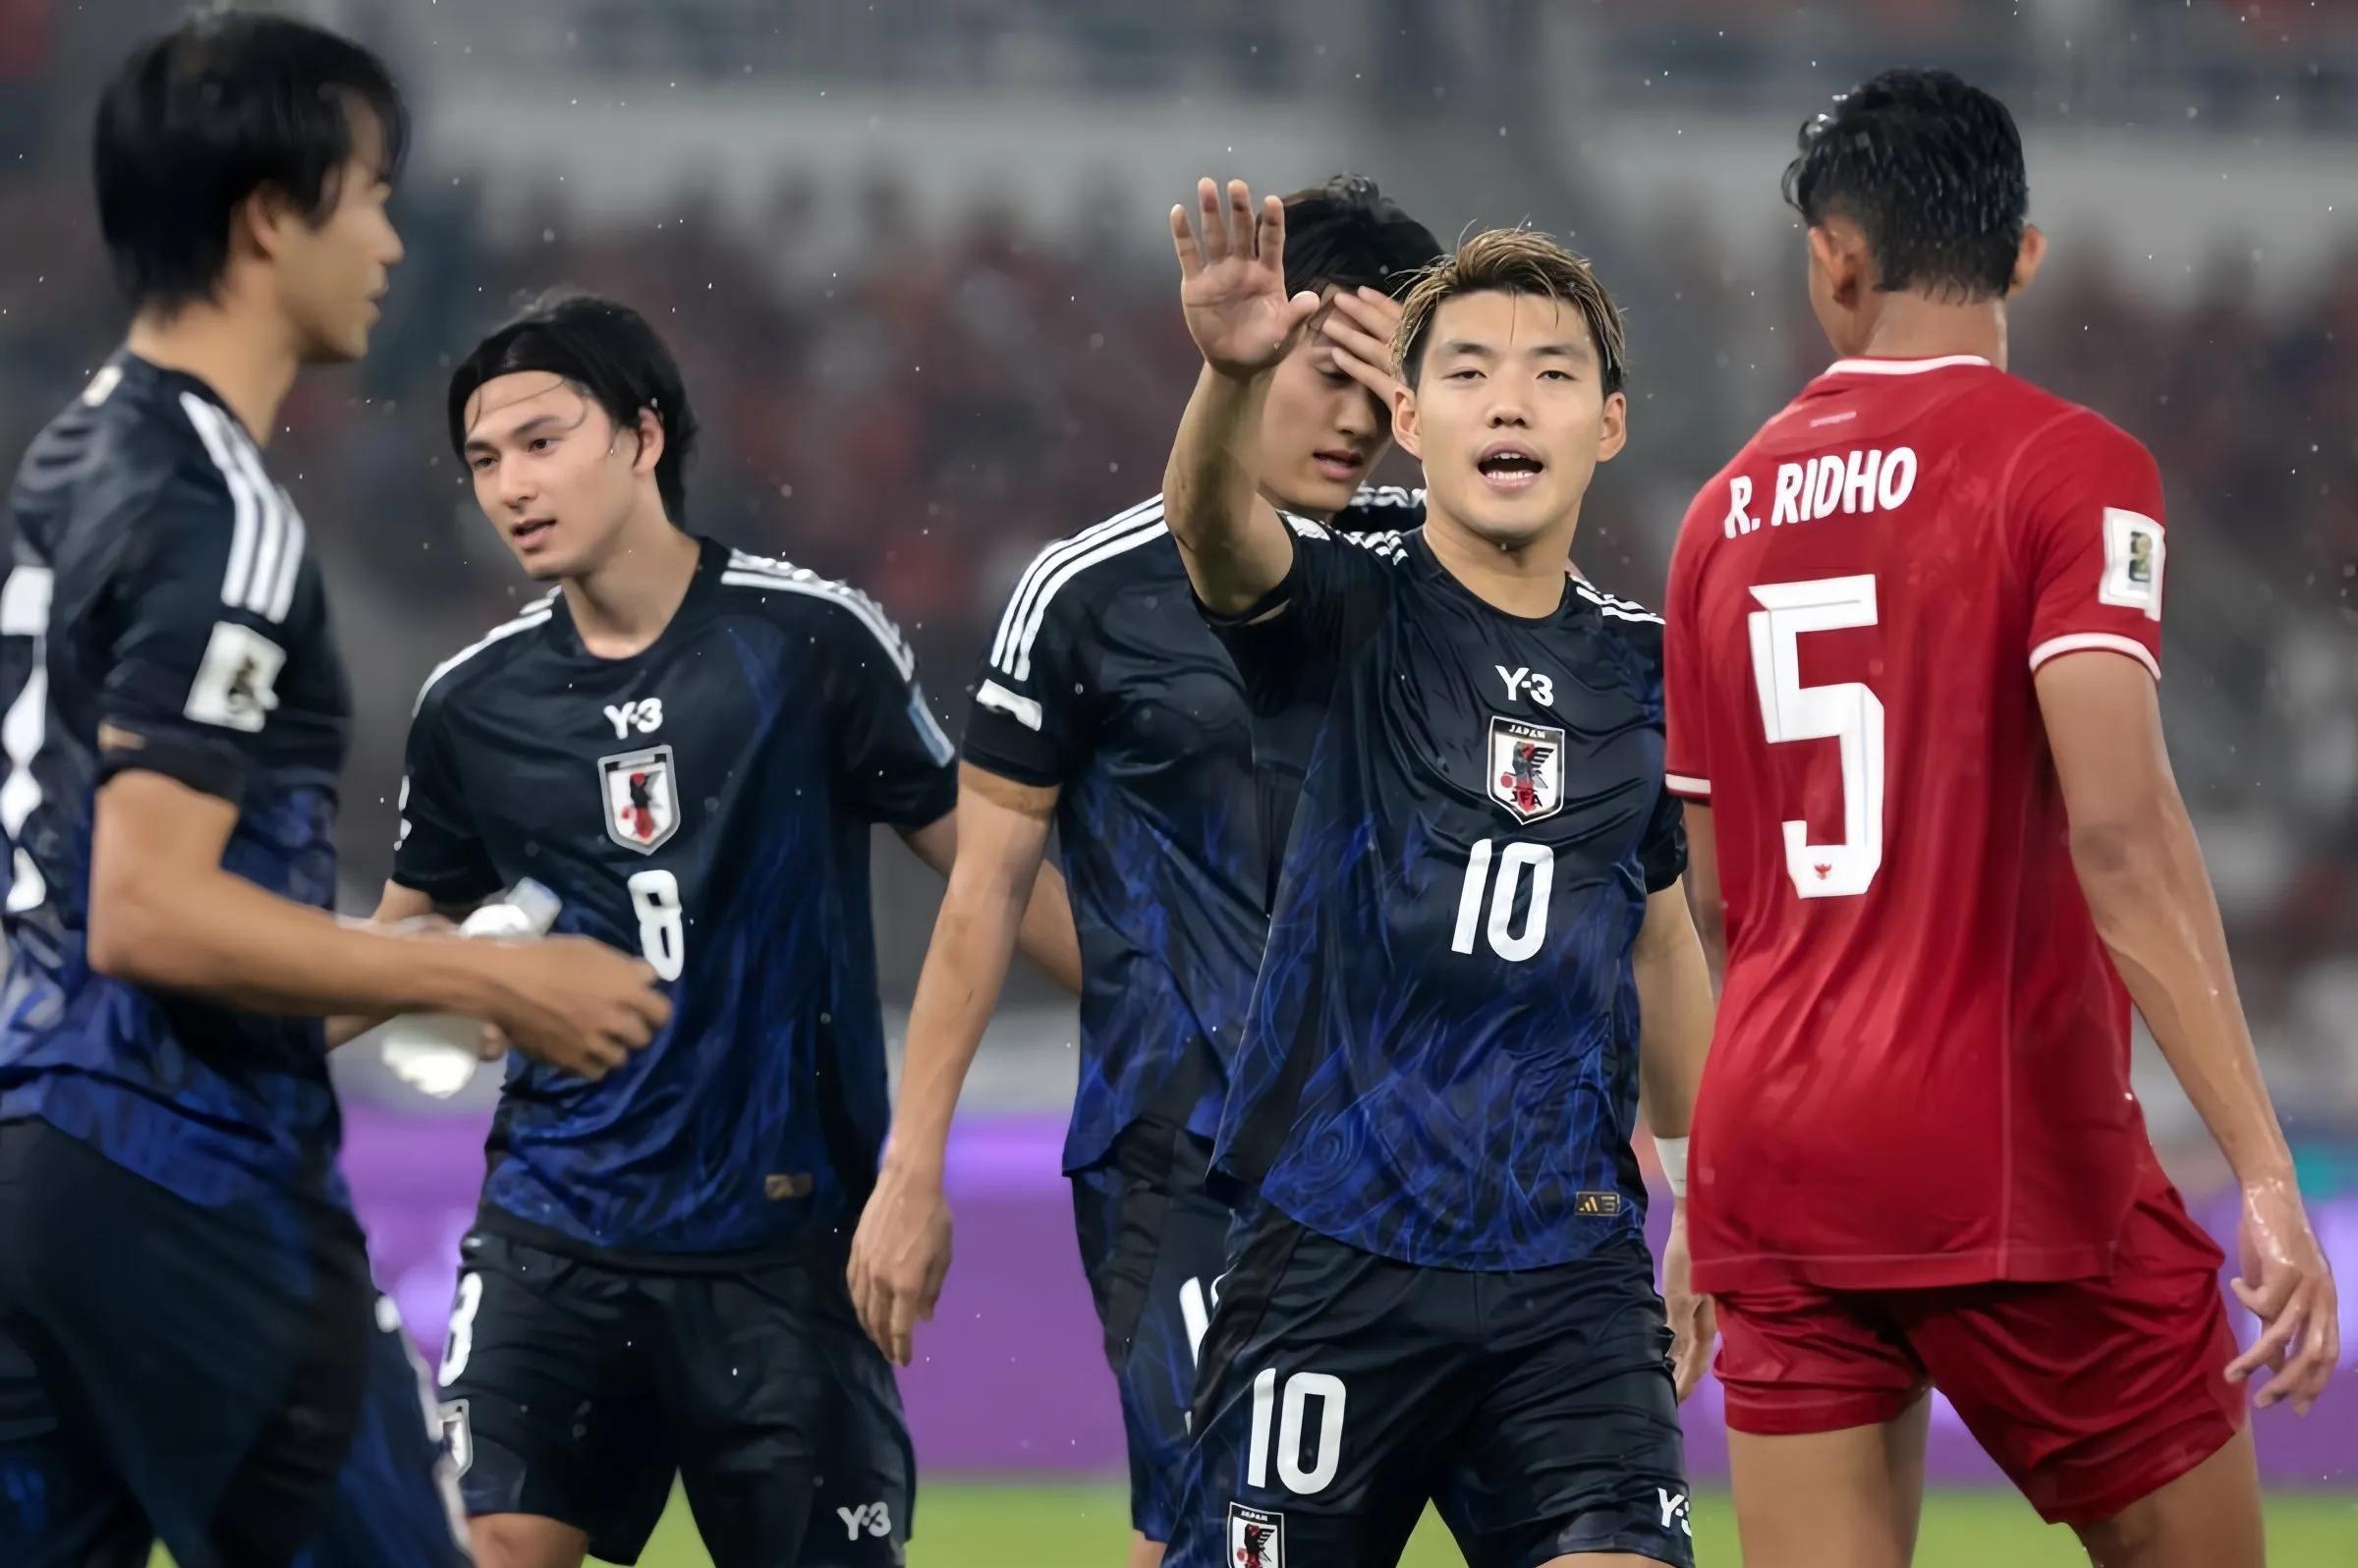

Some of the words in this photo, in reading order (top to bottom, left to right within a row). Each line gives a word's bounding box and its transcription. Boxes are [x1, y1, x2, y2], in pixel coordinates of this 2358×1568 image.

[1724, 476, 1761, 539] R.
[1771, 447, 1917, 527] RIDHO
[603, 698, 663, 739] Y-3
[1495, 665, 1554, 706] Y-3
[1509, 725, 1545, 739] JAPAN
[1748, 574, 1884, 899] 5
[628, 869, 684, 981] 8
[1451, 838, 1554, 961] 10
[1248, 1368, 1347, 1494] 10
[836, 1501, 891, 1540] Y-3
